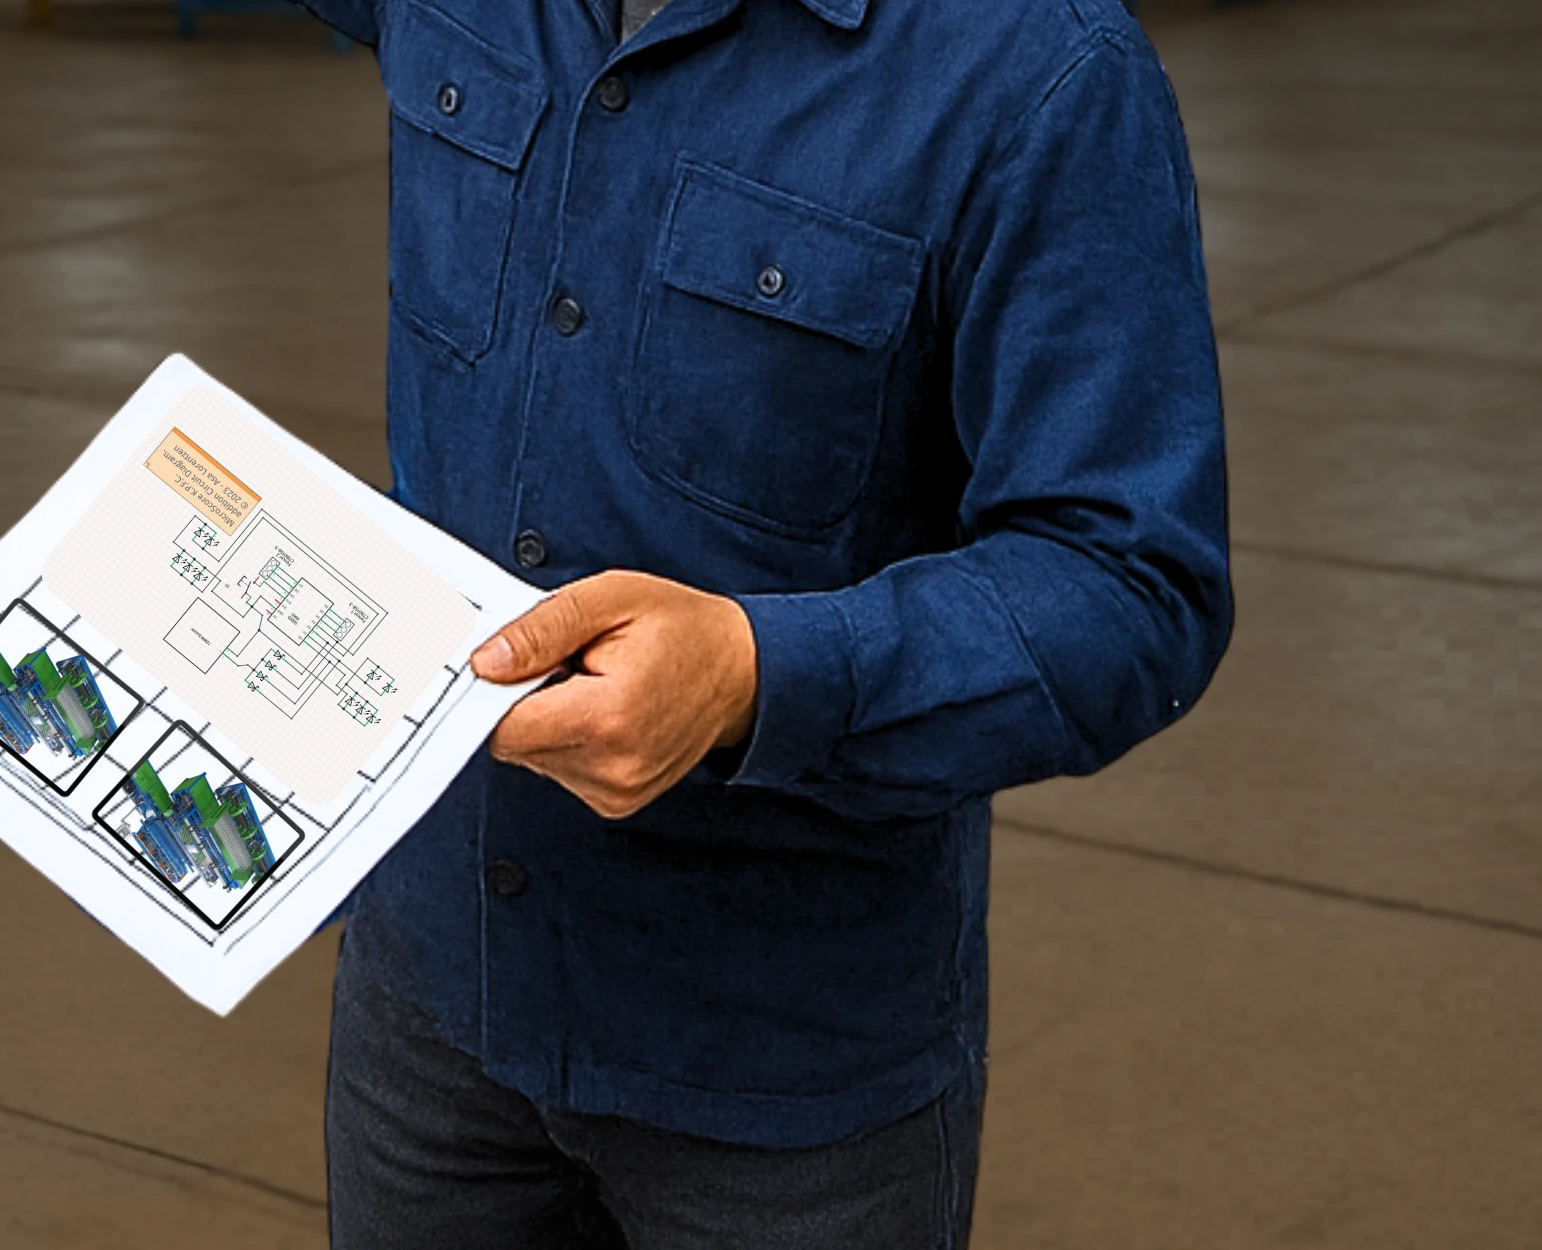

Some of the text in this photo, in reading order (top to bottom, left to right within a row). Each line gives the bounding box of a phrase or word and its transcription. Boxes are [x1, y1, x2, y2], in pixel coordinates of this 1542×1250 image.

[173, 445, 208, 475] Lorentzen
[163, 449, 242, 518] addition Circuit Diagram.
[206, 472, 221, 486] Asa
[222, 486, 242, 504] 2023
[197, 494, 235, 527] MicroScore
